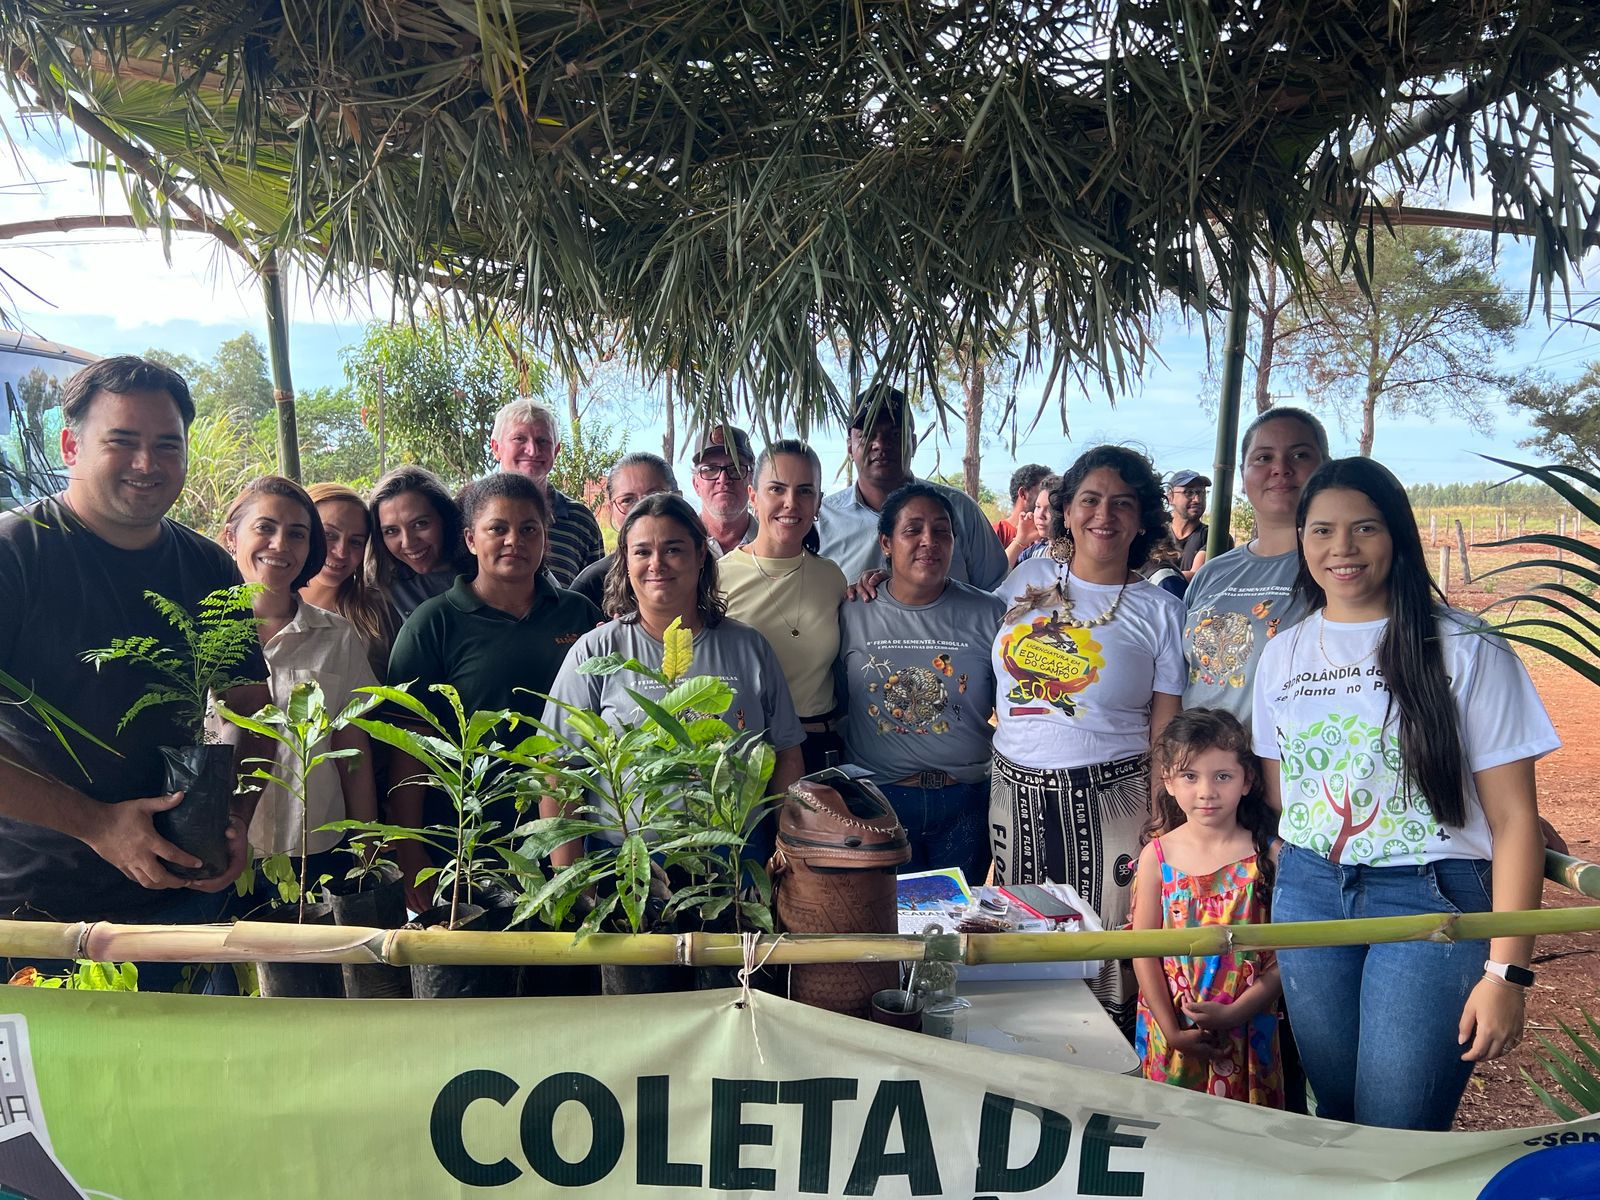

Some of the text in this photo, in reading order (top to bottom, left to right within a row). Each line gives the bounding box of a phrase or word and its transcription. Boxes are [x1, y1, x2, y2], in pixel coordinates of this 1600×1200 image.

[937, 640, 969, 648] CRIOULAS
[1019, 649, 1079, 675] EDUCAÇÃO
[1027, 643, 1081, 667] LICENCIATURA EM
[1024, 658, 1070, 679] DO CAMPO
[1282, 667, 1361, 691] SIDROLÂNDIA
[1293, 685, 1336, 700] planta
[1346, 684, 1361, 694] no
[1114, 763, 1134, 776] FLOR
[1020, 798, 1029, 819] FLOR
[1075, 803, 1086, 824] FLOR
[1023, 835, 1032, 857] FLOR
[1080, 840, 1090, 862] FLOR
[429, 1069, 1161, 1197] COLETA DE
